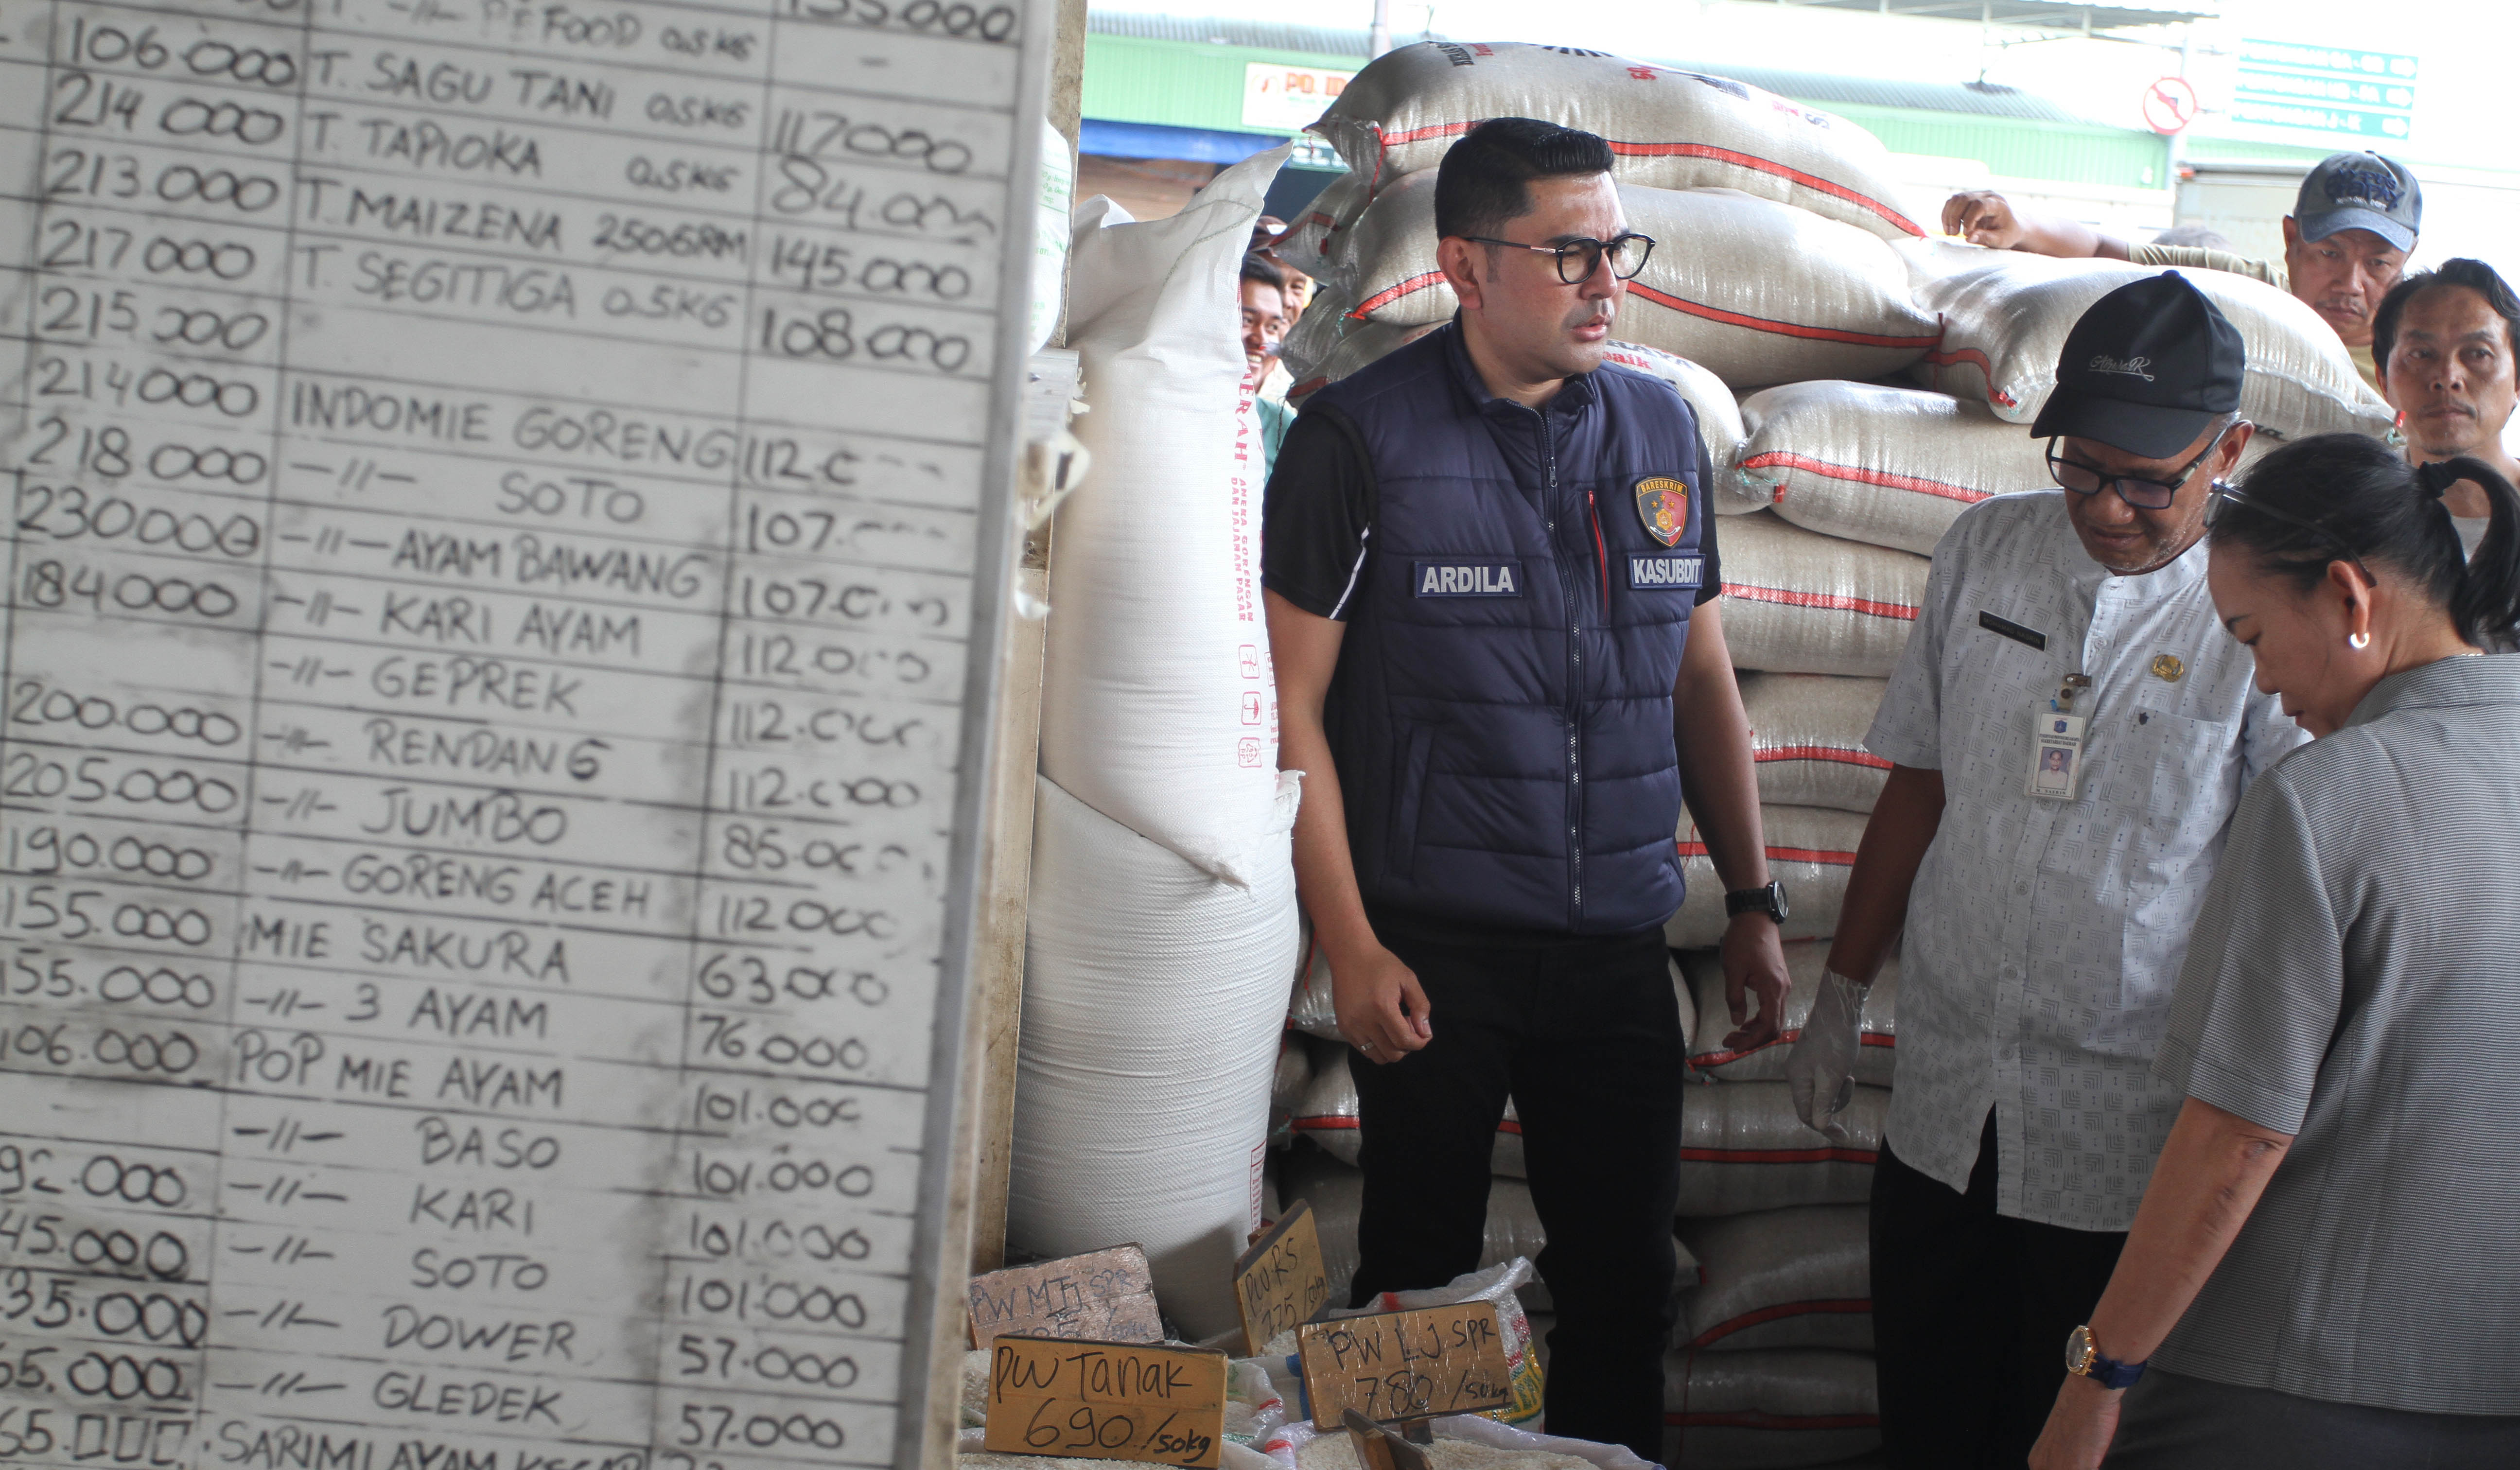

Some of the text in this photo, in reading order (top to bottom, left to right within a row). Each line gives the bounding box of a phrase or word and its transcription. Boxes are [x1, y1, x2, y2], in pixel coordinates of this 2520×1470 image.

[542, 7, 641, 47] FOOD
[313, 49, 349, 88] T.
[368, 50, 492, 105] SAGU
[509, 70, 616, 120] TANI
[308, 111, 342, 153] T.
[360, 118, 542, 175] TAPIOKA
[347, 188, 562, 253] MAIZENA
[353, 250, 577, 329] SEGITIGA
[293, 380, 737, 471] INDOMIE GORENG
[495, 470, 645, 524] SOTO
[1239, 478, 1248, 526] ANEKA
[1641, 481, 1683, 492] BARESKRIM
[392, 528, 501, 578] AYAM
[511, 532, 710, 599] BAWANG
[1232, 509, 1242, 572] JAJANAN
[1241, 536, 1253, 621] GORENGAN
[1421, 567, 1515, 594] ARDILA
[1632, 555, 1702, 584] KASUBDIT
[379, 591, 492, 645] KARI
[515, 602, 640, 657] AYAM
[1237, 578, 1246, 621] PASAR
[12, 681, 242, 746] 200.000
[370, 656, 582, 717] GEPREK
[4, 752, 238, 813] 205.000
[360, 786, 567, 844] JUMBO
[8, 825, 212, 881] 190.000
[343, 854, 522, 905] GORENG
[531, 873, 650, 918] ACEH
[3, 885, 211, 946] 155.000
[246, 913, 570, 984] MIE SAKURA
[345, 982, 381, 1022] 3
[408, 988, 547, 1038] AYAM
[0, 1022, 199, 1073] 106.000
[232, 1027, 564, 1110] POP MIE AYAM
[416, 1117, 561, 1169] BASO
[694, 1151, 874, 1199] 101.000
[409, 1182, 533, 1235] KARI
[411, 1248, 548, 1291] SOTO
[384, 1304, 576, 1360] DOWER
[1329, 1330, 1383, 1371] PW
[1452, 1318, 1496, 1348] SPR
[679, 1335, 858, 1390] 57.000
[1066, 1352, 1193, 1403] Tanak
[373, 1371, 563, 1425] GLEDEK
[1356, 1370, 1433, 1415] 780
[218, 1420, 373, 1470] SARIMI
[680, 1403, 843, 1450] 57.000
